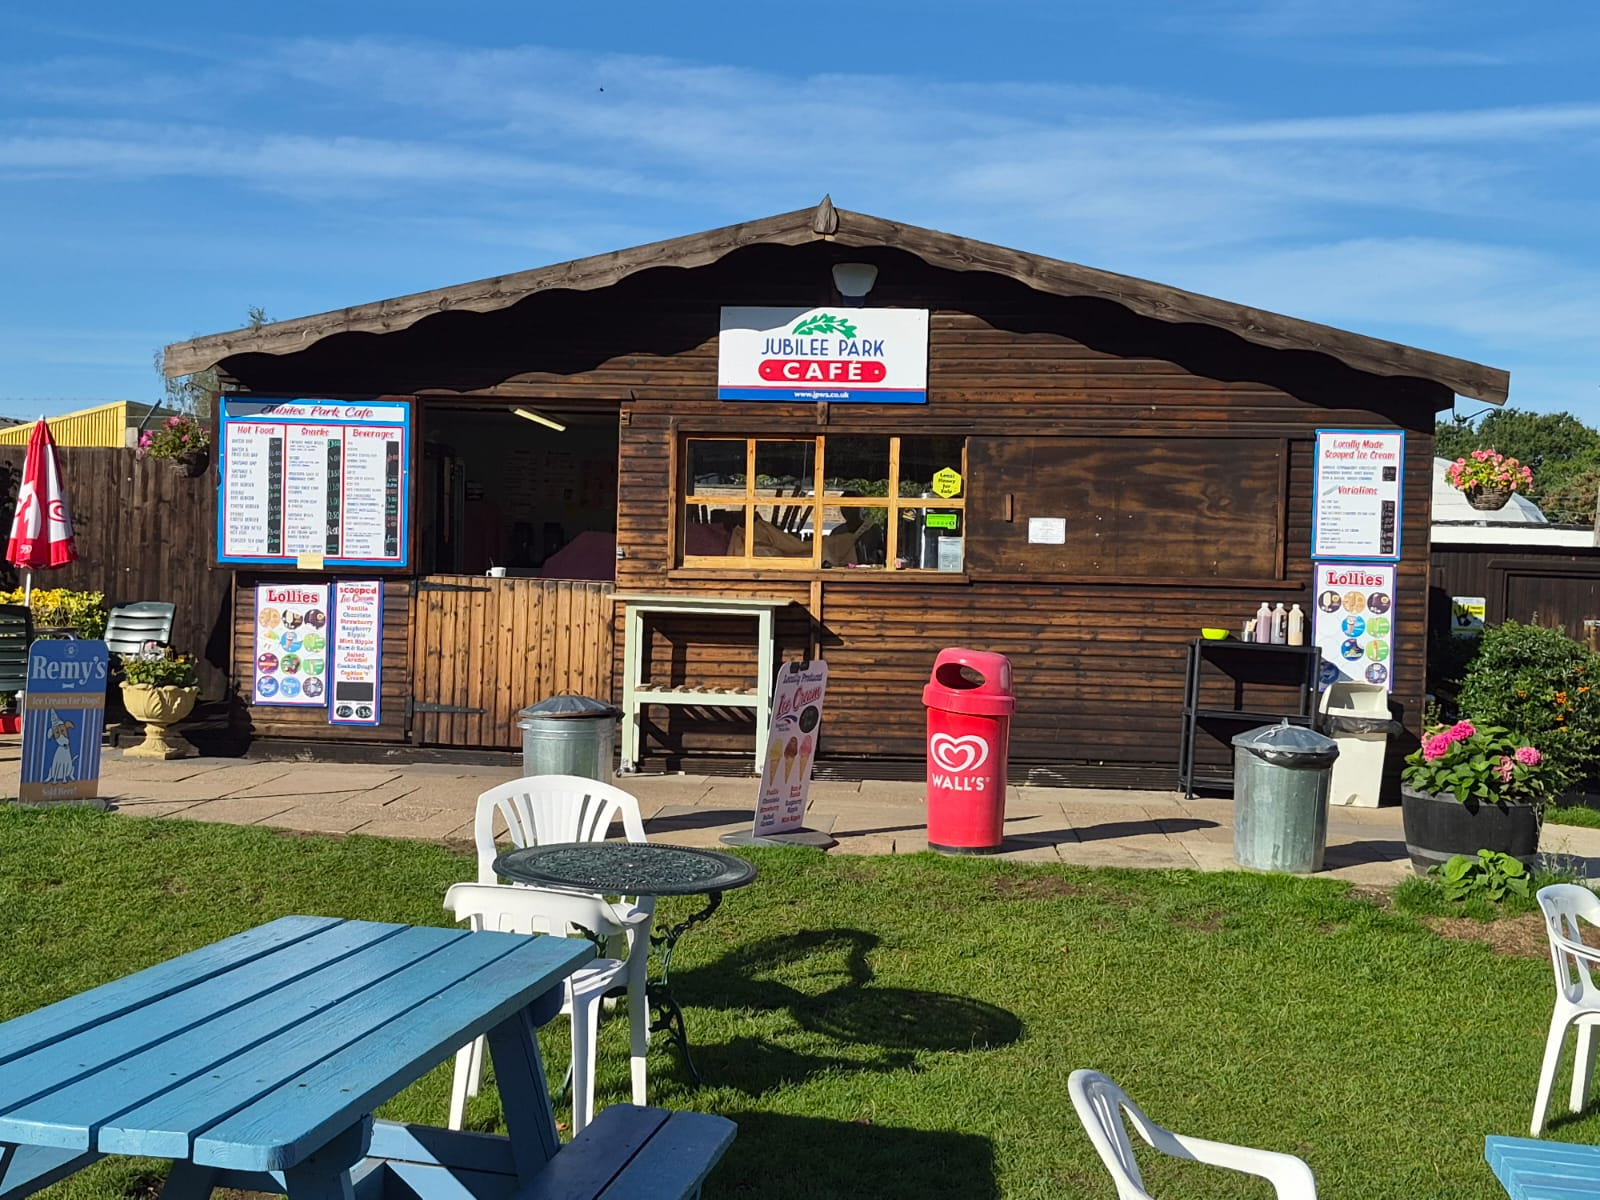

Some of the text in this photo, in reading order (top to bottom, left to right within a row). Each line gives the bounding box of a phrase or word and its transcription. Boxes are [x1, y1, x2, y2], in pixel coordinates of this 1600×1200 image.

[761, 338, 885, 357] JUBILEE PARK
[783, 360, 862, 381] CAFÉ
[260, 406, 305, 416] Jubilee
[310, 407, 340, 417] Park
[237, 425, 276, 435] Hot Food
[301, 427, 330, 437] Snacks
[352, 429, 395, 440] Beverages
[1333, 440, 1384, 450] Locally Made
[1324, 450, 1396, 460] Scooped Ice Cream
[1338, 485, 1379, 495] Variations
[1327, 572, 1384, 586] Lollies
[267, 590, 318, 603] Lollies
[31, 655, 106, 685] Remy's
[32, 696, 44, 705] Ice
[44, 696, 69, 705] Cream
[776, 686, 822, 717] Ice Cream
[932, 773, 984, 791] WALL'S
[42, 786, 78, 797] Sold Here!
